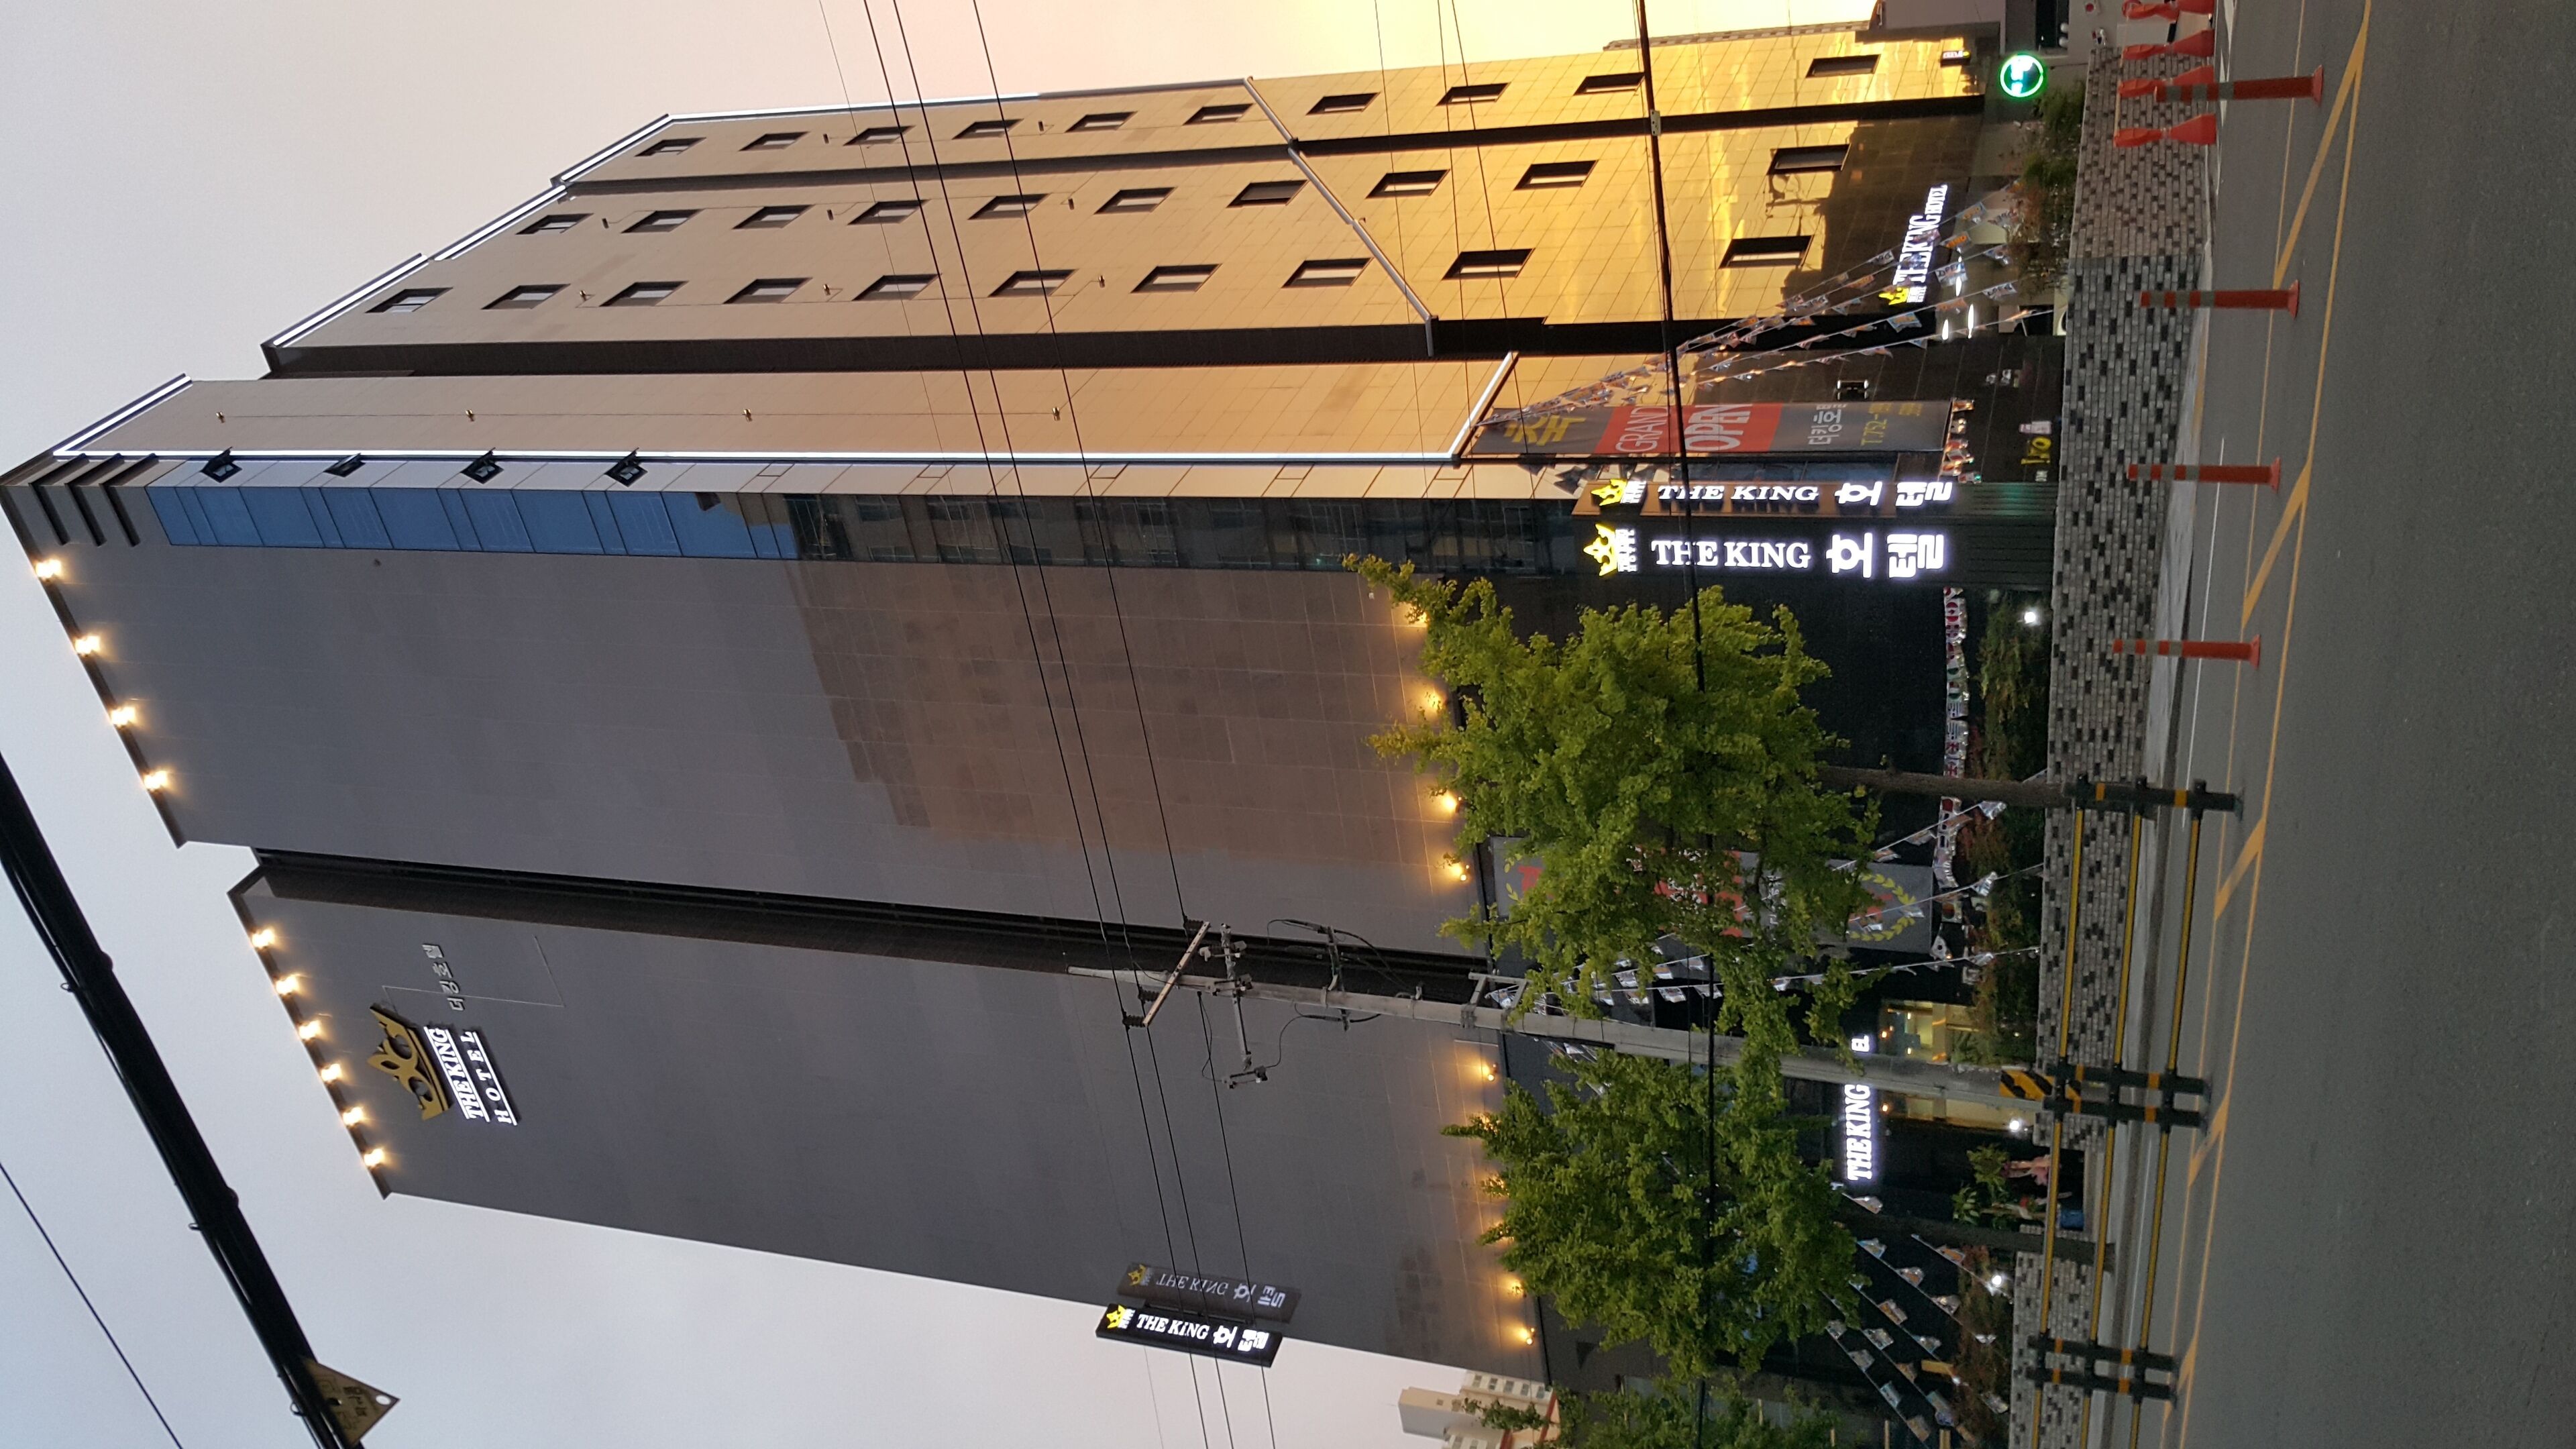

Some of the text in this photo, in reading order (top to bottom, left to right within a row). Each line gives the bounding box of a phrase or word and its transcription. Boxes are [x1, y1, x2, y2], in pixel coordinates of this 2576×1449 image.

[1925, 183, 1948, 213] HOTEL
[1615, 405, 1670, 453] GRAND
[1684, 404, 1752, 452] OPEN
[1658, 485, 1724, 500] THE
[1731, 485, 1819, 501] KING
[1835, 480, 1953, 507] 호텔
[1651, 539, 1717, 567] THE
[1723, 541, 1811, 569] KING
[1825, 532, 1945, 580] 호텔
[421, 943, 467, 1011] 더킹호텔
[429, 1027, 486, 1118] THE KING
[461, 1030, 513, 1123] HOTEL
[1844, 1083, 1872, 1180] THE KING
[1136, 1313, 1169, 1331] THE
[1167, 1318, 1210, 1339] KING
[1213, 1324, 1270, 1351] 호텔
